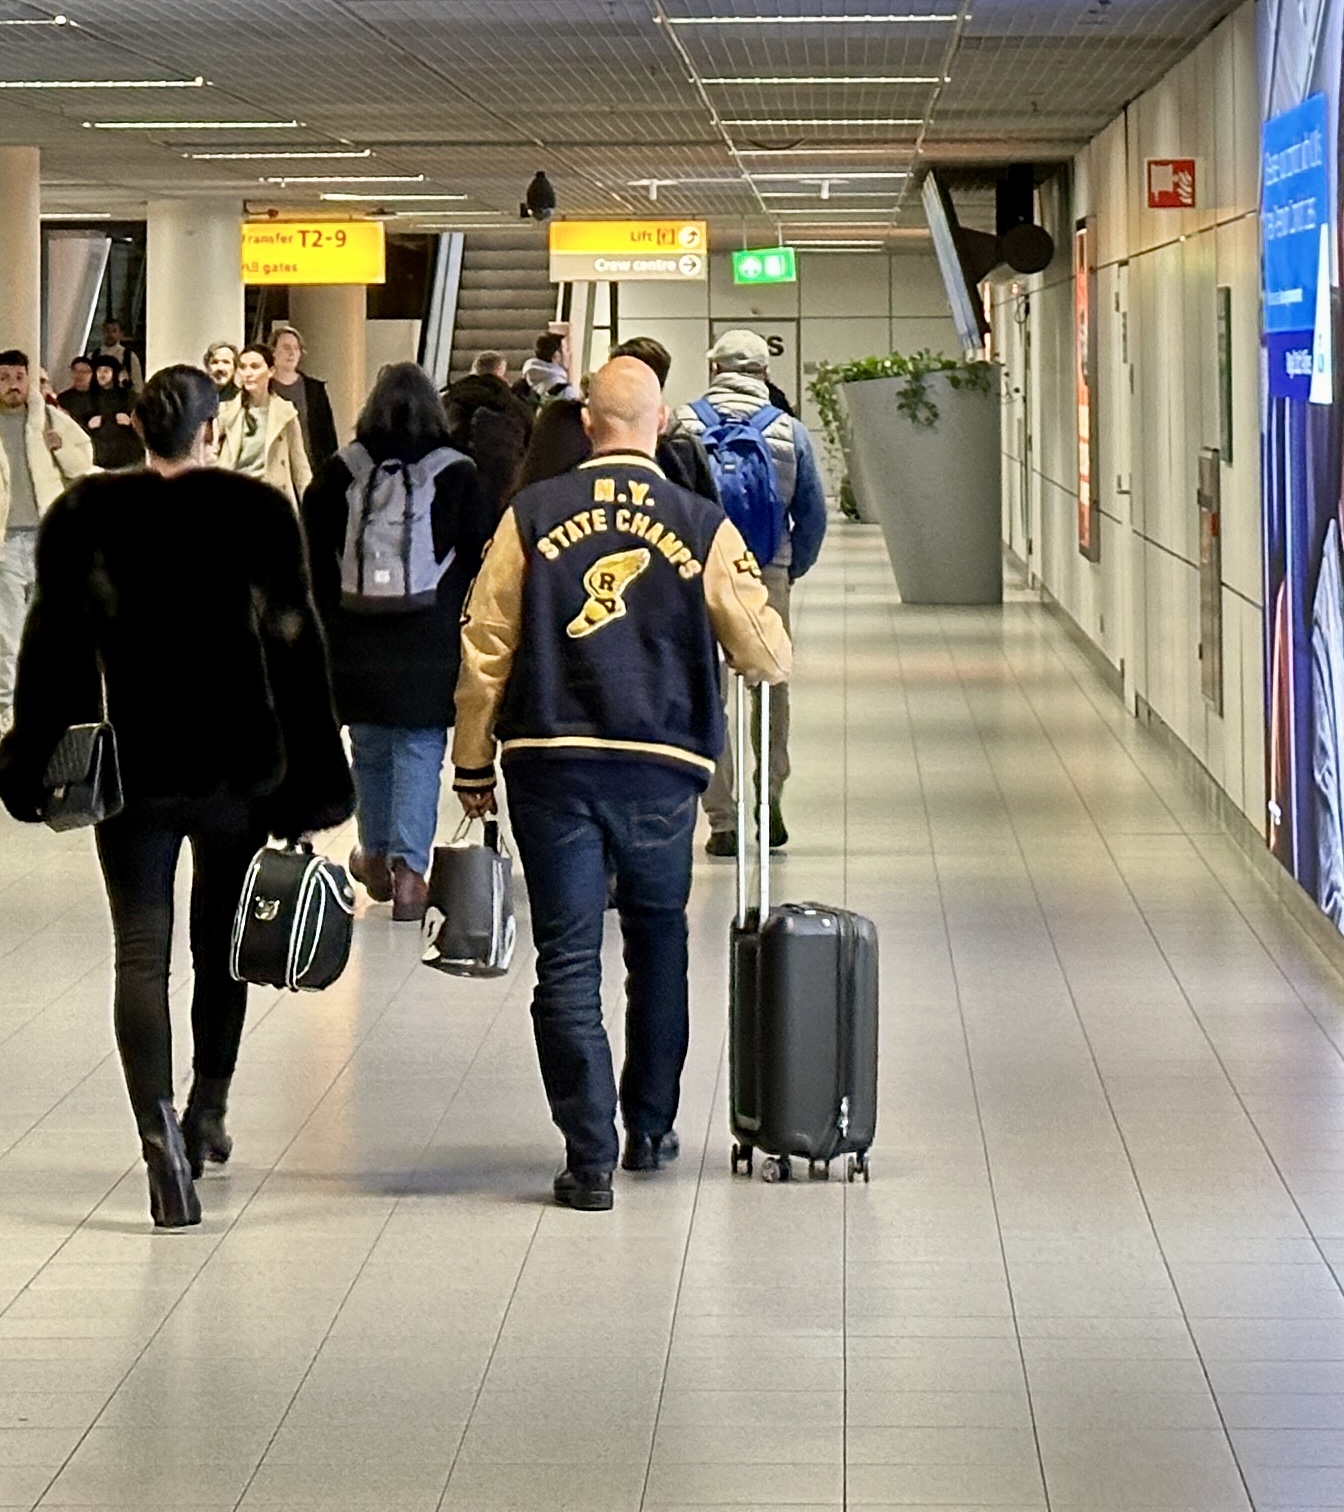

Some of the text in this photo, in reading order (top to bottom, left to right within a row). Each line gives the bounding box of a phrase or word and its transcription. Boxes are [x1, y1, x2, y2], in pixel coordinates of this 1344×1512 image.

[297, 229, 347, 248] T2-9
[630, 231, 653, 243] Lift
[263, 263, 298, 276] gates
[594, 257, 677, 272] Crew centre
[594, 478, 655, 507] N.Y.
[537, 508, 702, 579] STATE CHAMPS
[598, 572, 616, 591] R
